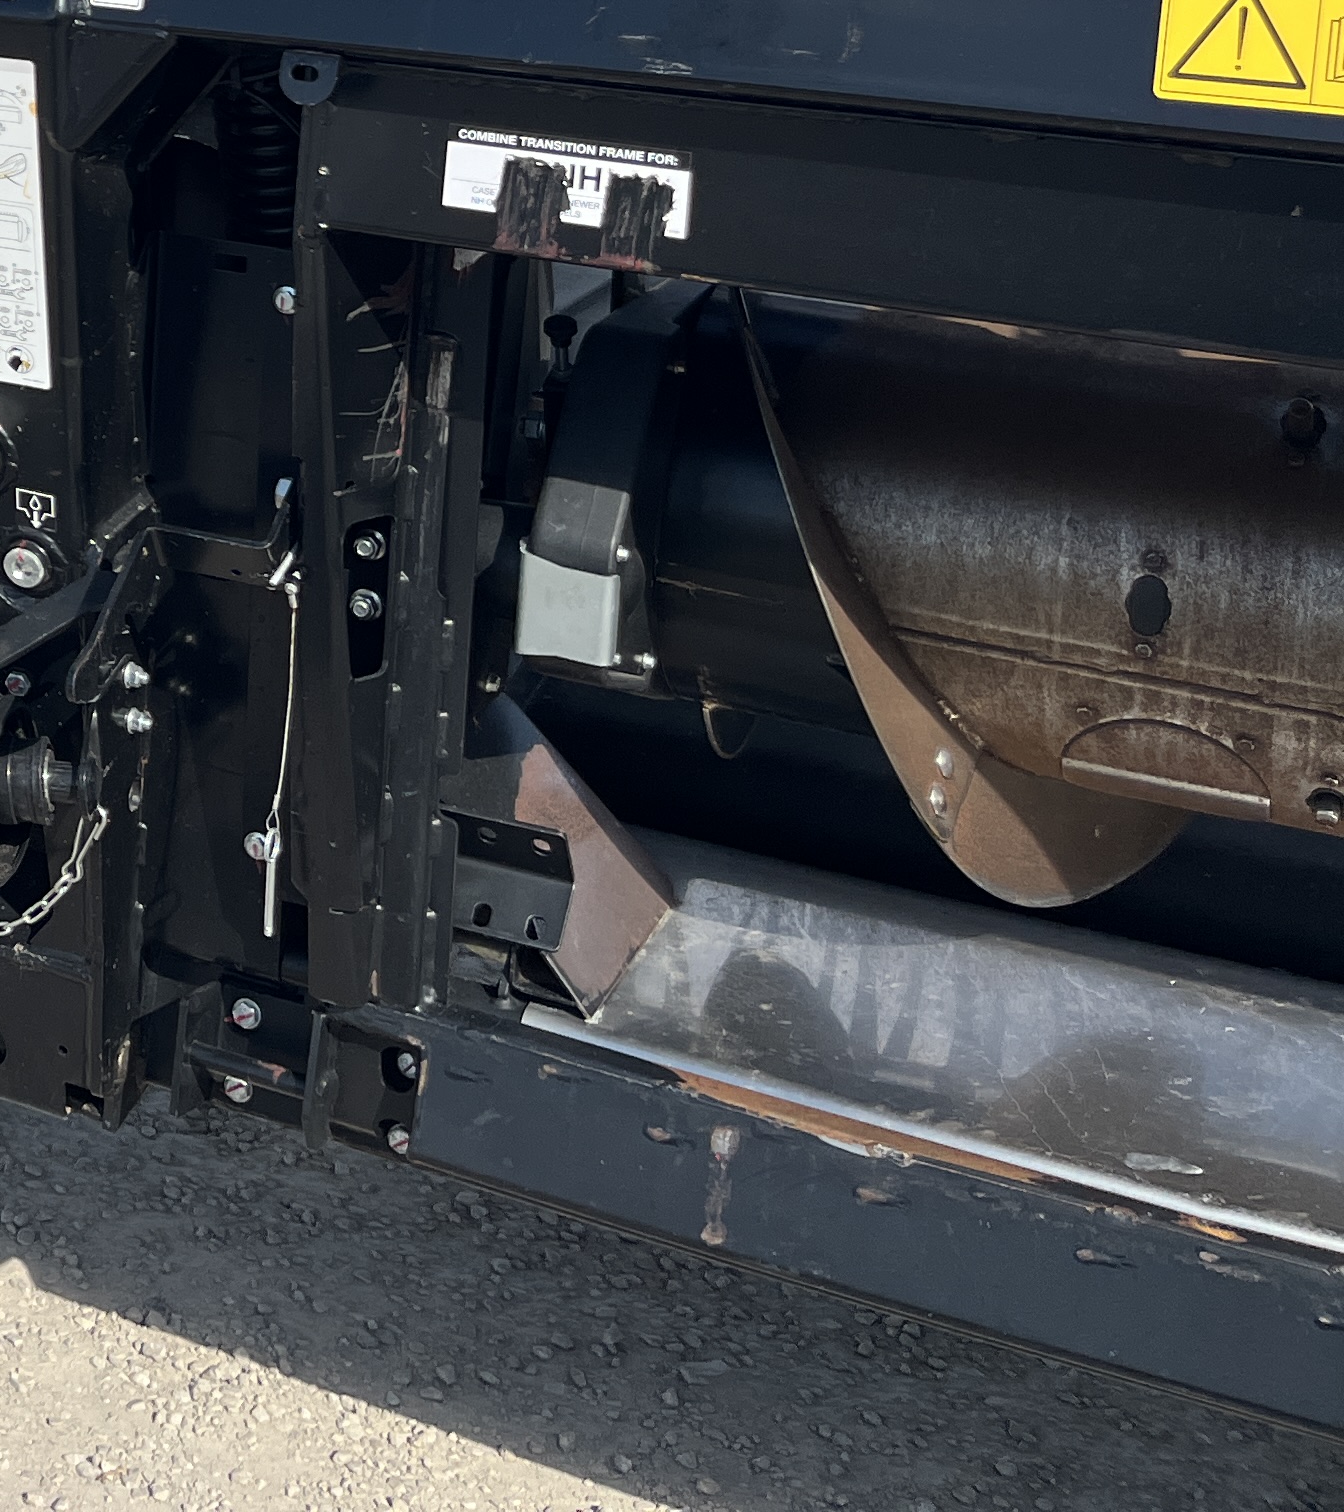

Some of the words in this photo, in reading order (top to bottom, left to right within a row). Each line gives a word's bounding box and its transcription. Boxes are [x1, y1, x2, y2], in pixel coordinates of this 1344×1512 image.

[458, 128, 517, 146] COMBINE
[519, 136, 596, 156] TRANSITION
[598, 146, 644, 162] FRAME
[647, 152, 679, 166] FOR:
[472, 186, 497, 196] CASE
